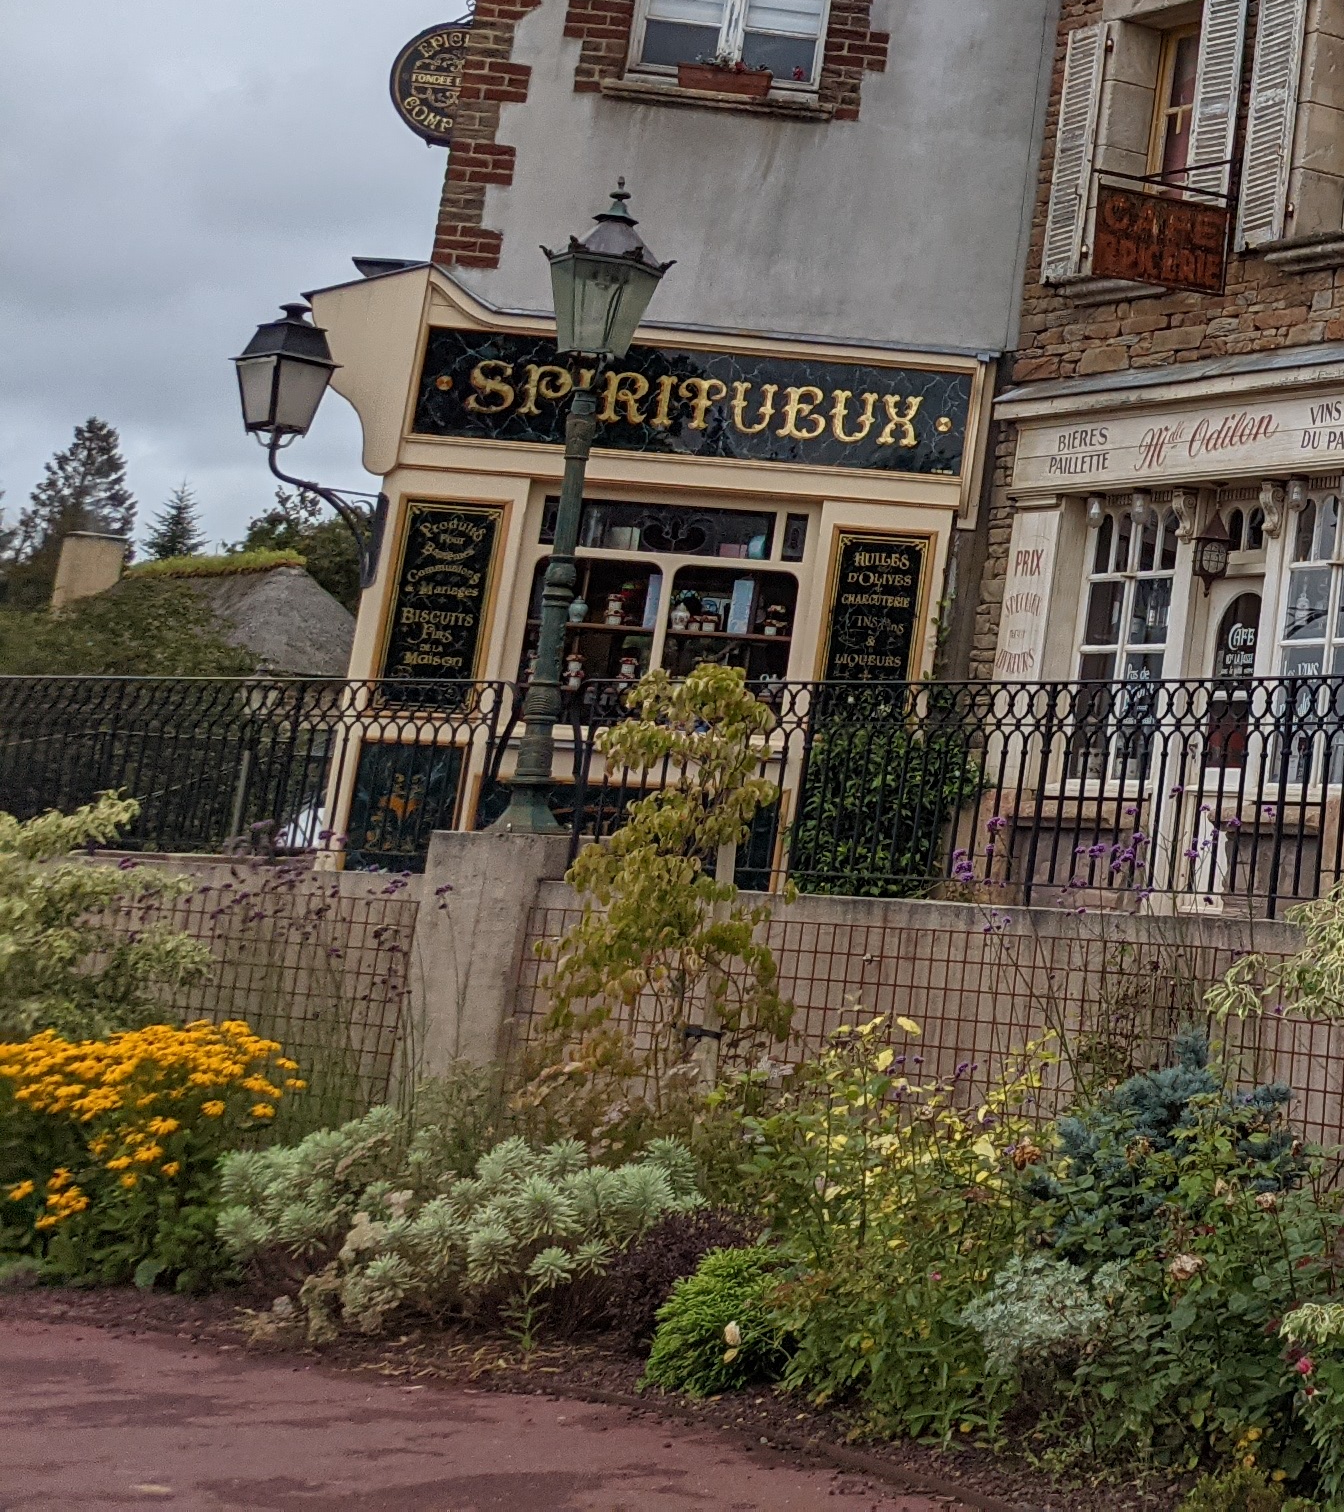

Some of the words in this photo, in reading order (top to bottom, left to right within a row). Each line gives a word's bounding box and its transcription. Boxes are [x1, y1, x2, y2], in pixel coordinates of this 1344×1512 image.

[1310, 403, 1343, 426] VINS
[1057, 426, 1109, 453] BIERES
[1187, 410, 1280, 459] Odilon
[1300, 429, 1321, 451] DU
[1048, 452, 1109, 476] PAILLETTE
[854, 551, 910, 570] HUILES
[1014, 549, 1045, 578] PRIX
[841, 593, 910, 609] CHARCUTERIE
[401, 607, 474, 627] BISCUITS
[1228, 623, 1256, 651] CAFE
[404, 651, 463, 668] Maison
[834, 653, 902, 668] LIQUEURS
